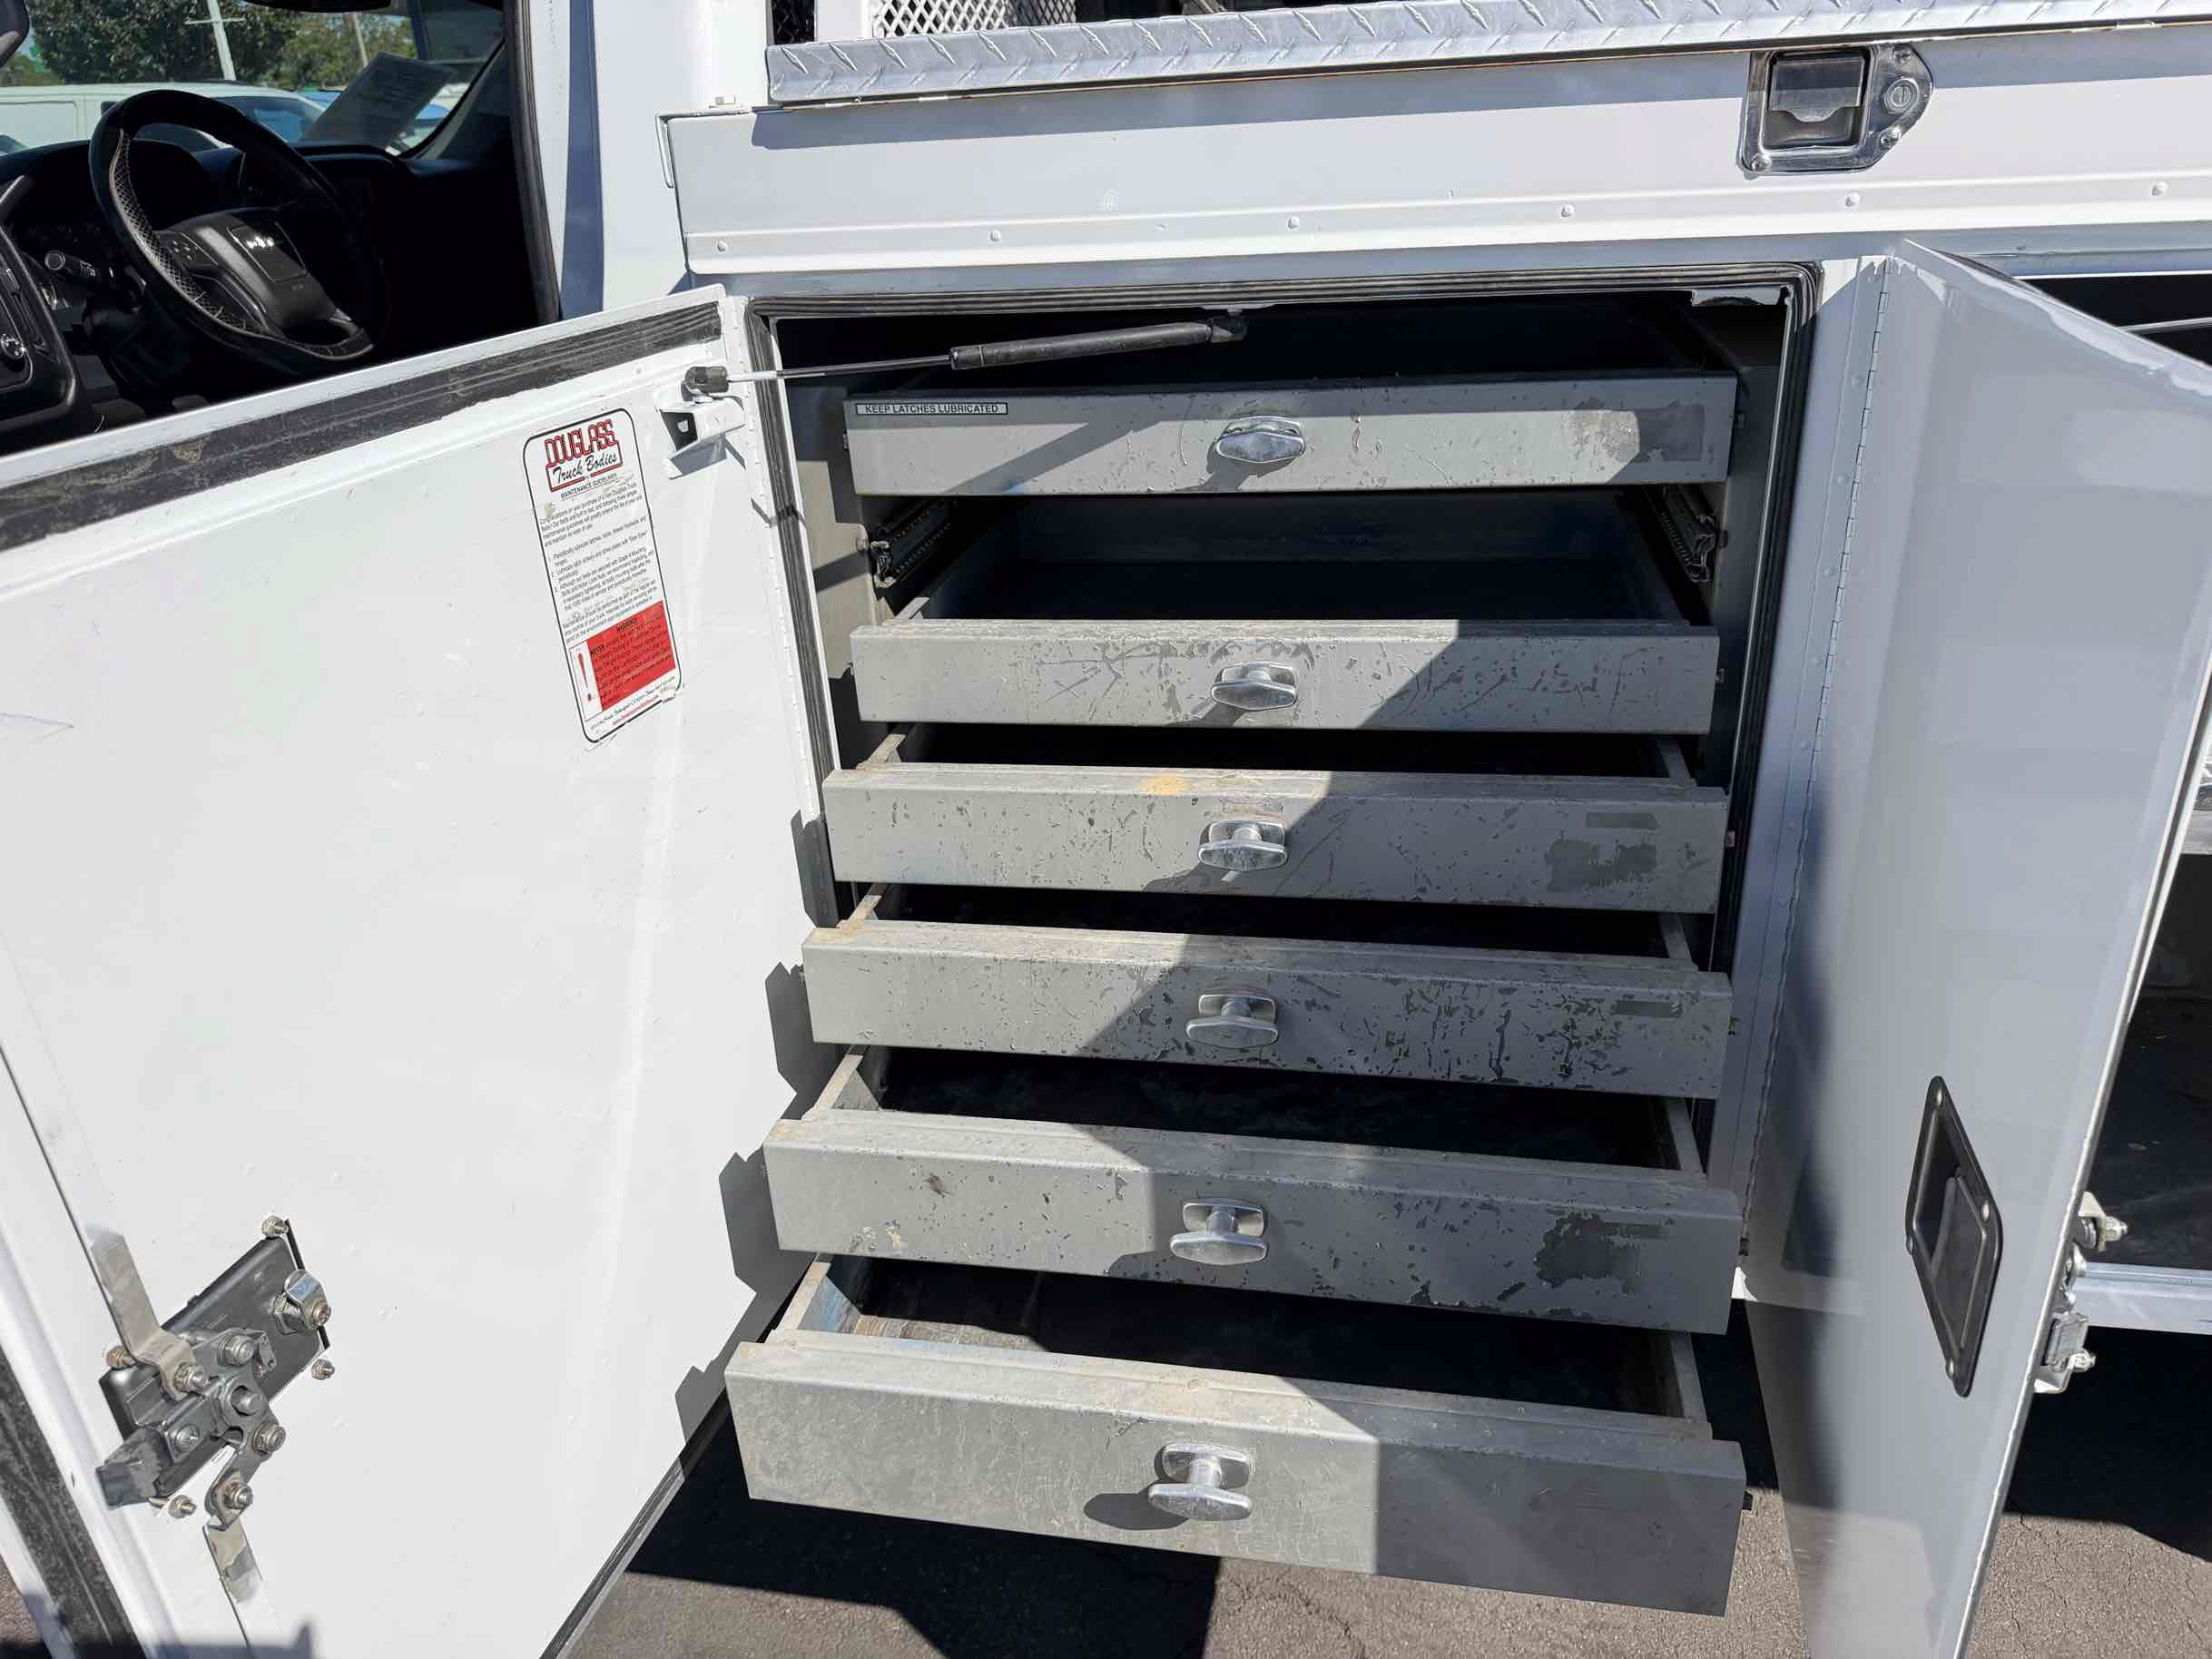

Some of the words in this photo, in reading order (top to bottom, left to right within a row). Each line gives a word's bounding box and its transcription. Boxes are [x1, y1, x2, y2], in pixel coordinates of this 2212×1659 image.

[865, 403, 890, 414] KEEP
[892, 403, 936, 414] LATCHES
[939, 403, 998, 414] LUBRICATED
[545, 418, 617, 467] DOUGLASS
[552, 465, 583, 484] Truck
[585, 451, 617, 472] Bodies
